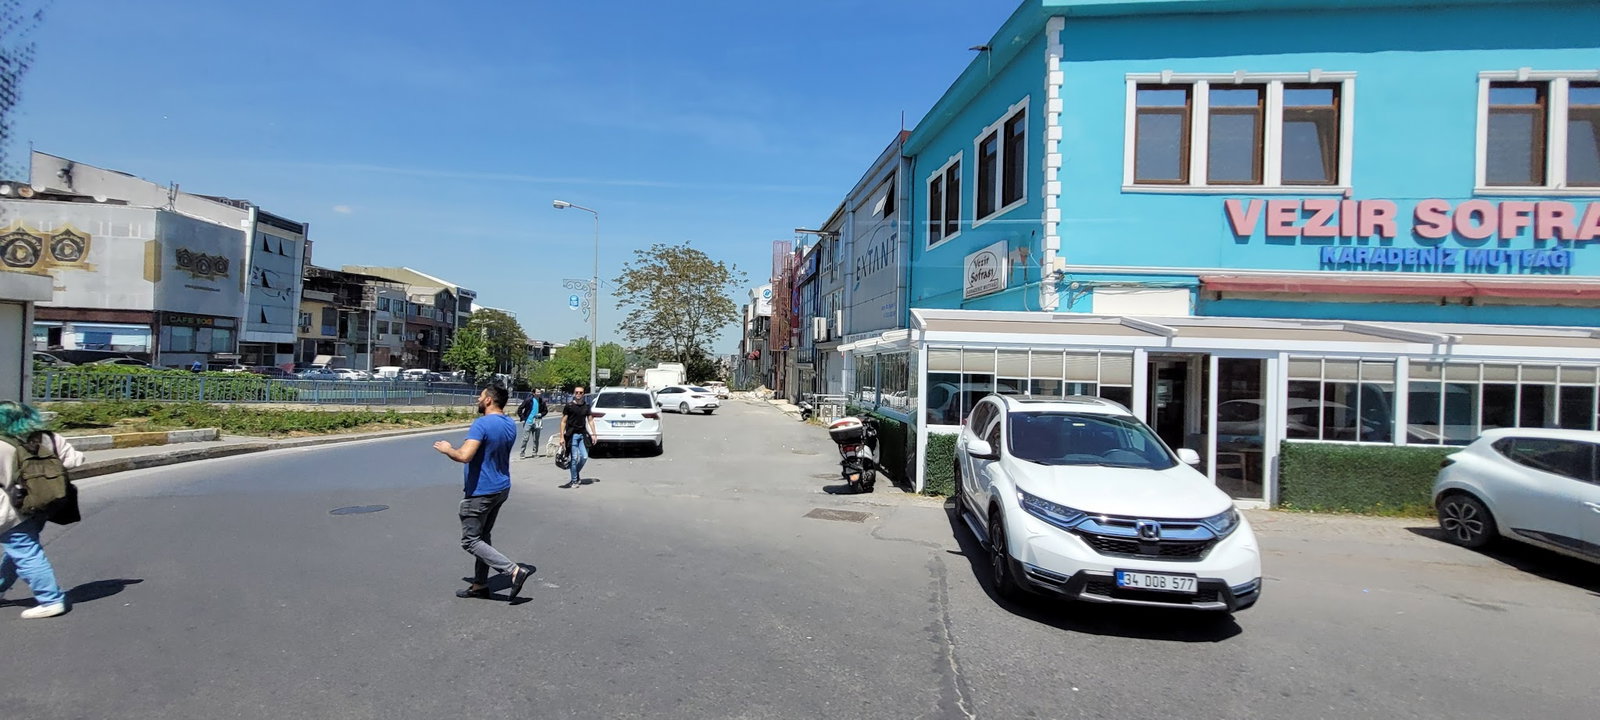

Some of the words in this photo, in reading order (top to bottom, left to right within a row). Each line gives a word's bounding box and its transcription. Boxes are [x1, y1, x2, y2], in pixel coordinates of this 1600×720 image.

[1224, 188, 1397, 238] VEZİR
[1413, 198, 1600, 241] SOFRA
[856, 232, 897, 282] EXTANT
[973, 255, 990, 269] Vezir
[1320, 244, 1458, 267] KARADENİZ
[1464, 245, 1575, 269] MUTFAĞI
[970, 268, 994, 284] Sofrası
[1124, 573, 1139, 586] 34
[1173, 577, 1194, 590] 577
